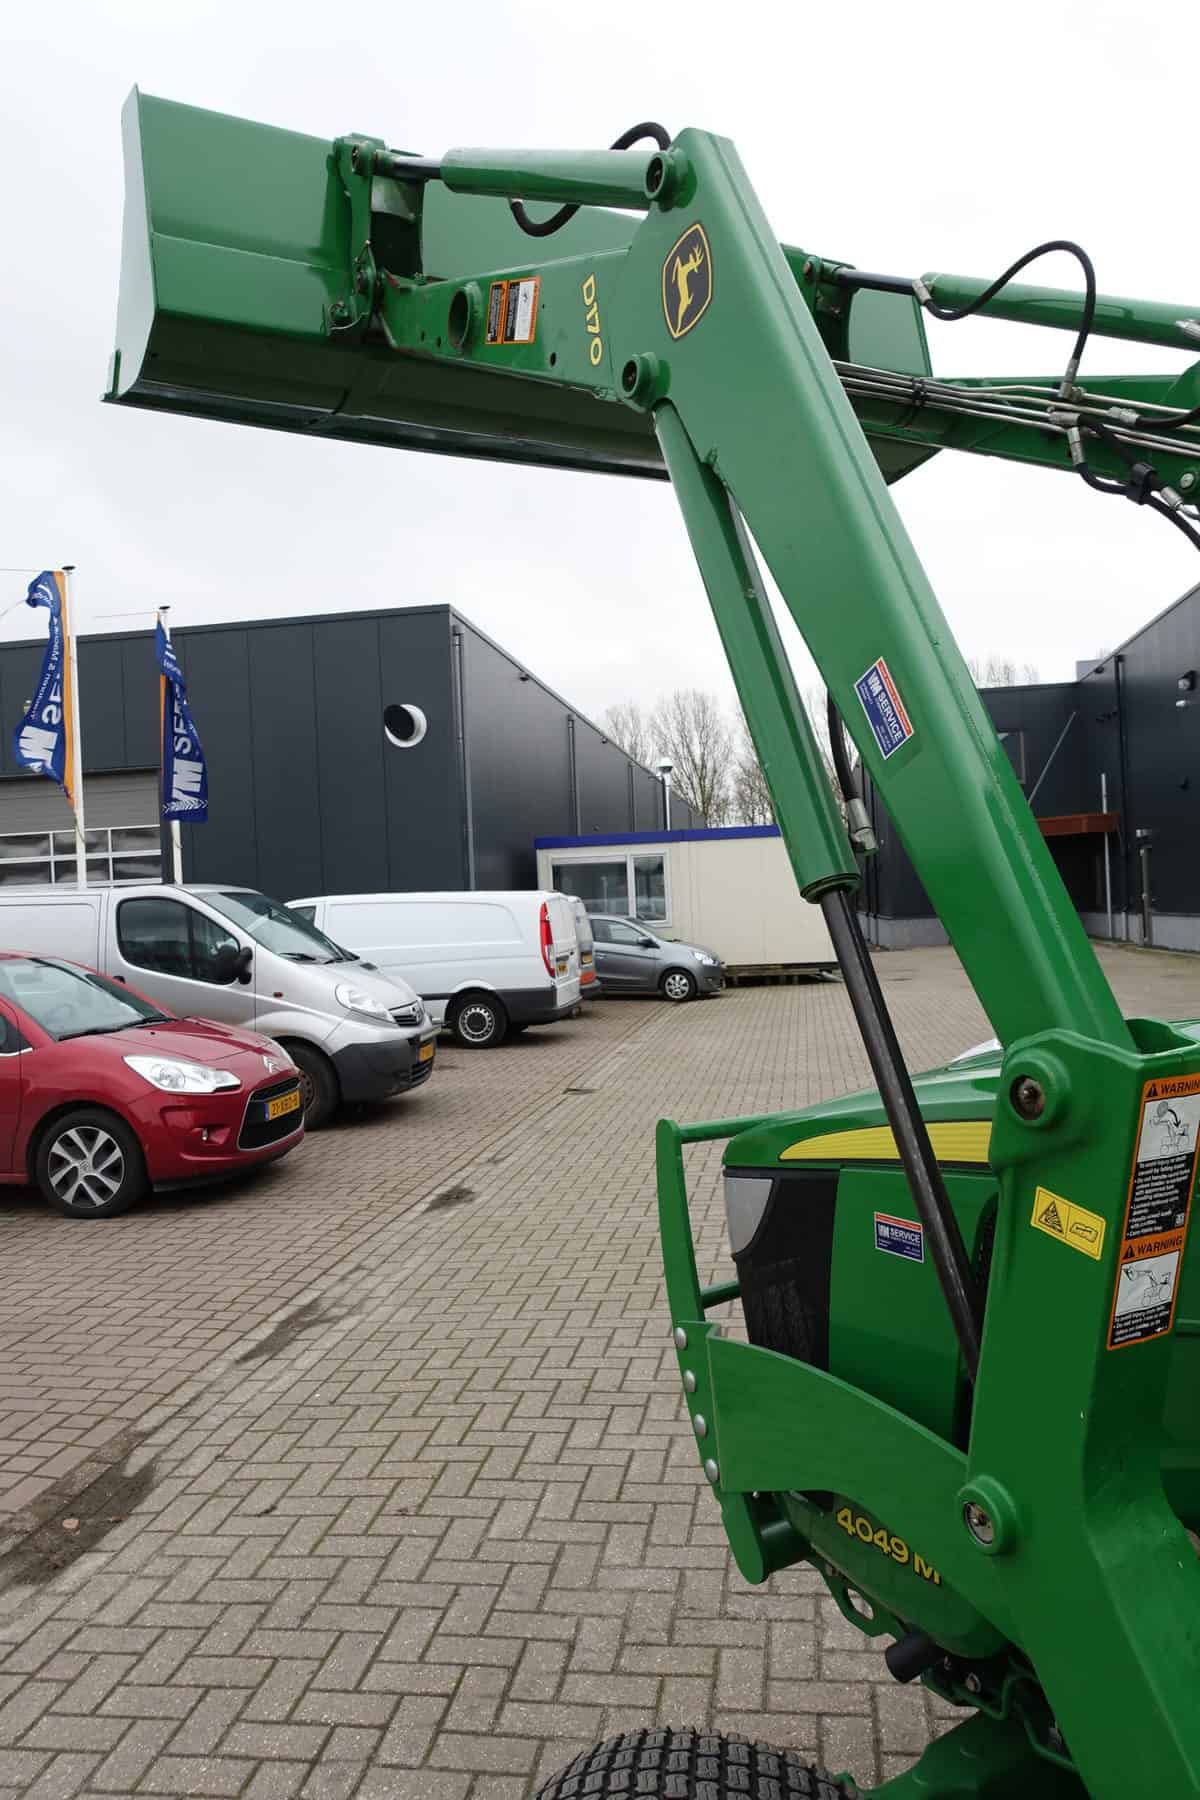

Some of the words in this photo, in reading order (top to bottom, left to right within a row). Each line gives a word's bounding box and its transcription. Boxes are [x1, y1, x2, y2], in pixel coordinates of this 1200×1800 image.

[879, 692, 903, 741] SERVICE
[1161, 1079, 1200, 1097] WARNIN
[1137, 1236, 1183, 1255] WARNING
[836, 1507, 909, 1564] 4049
